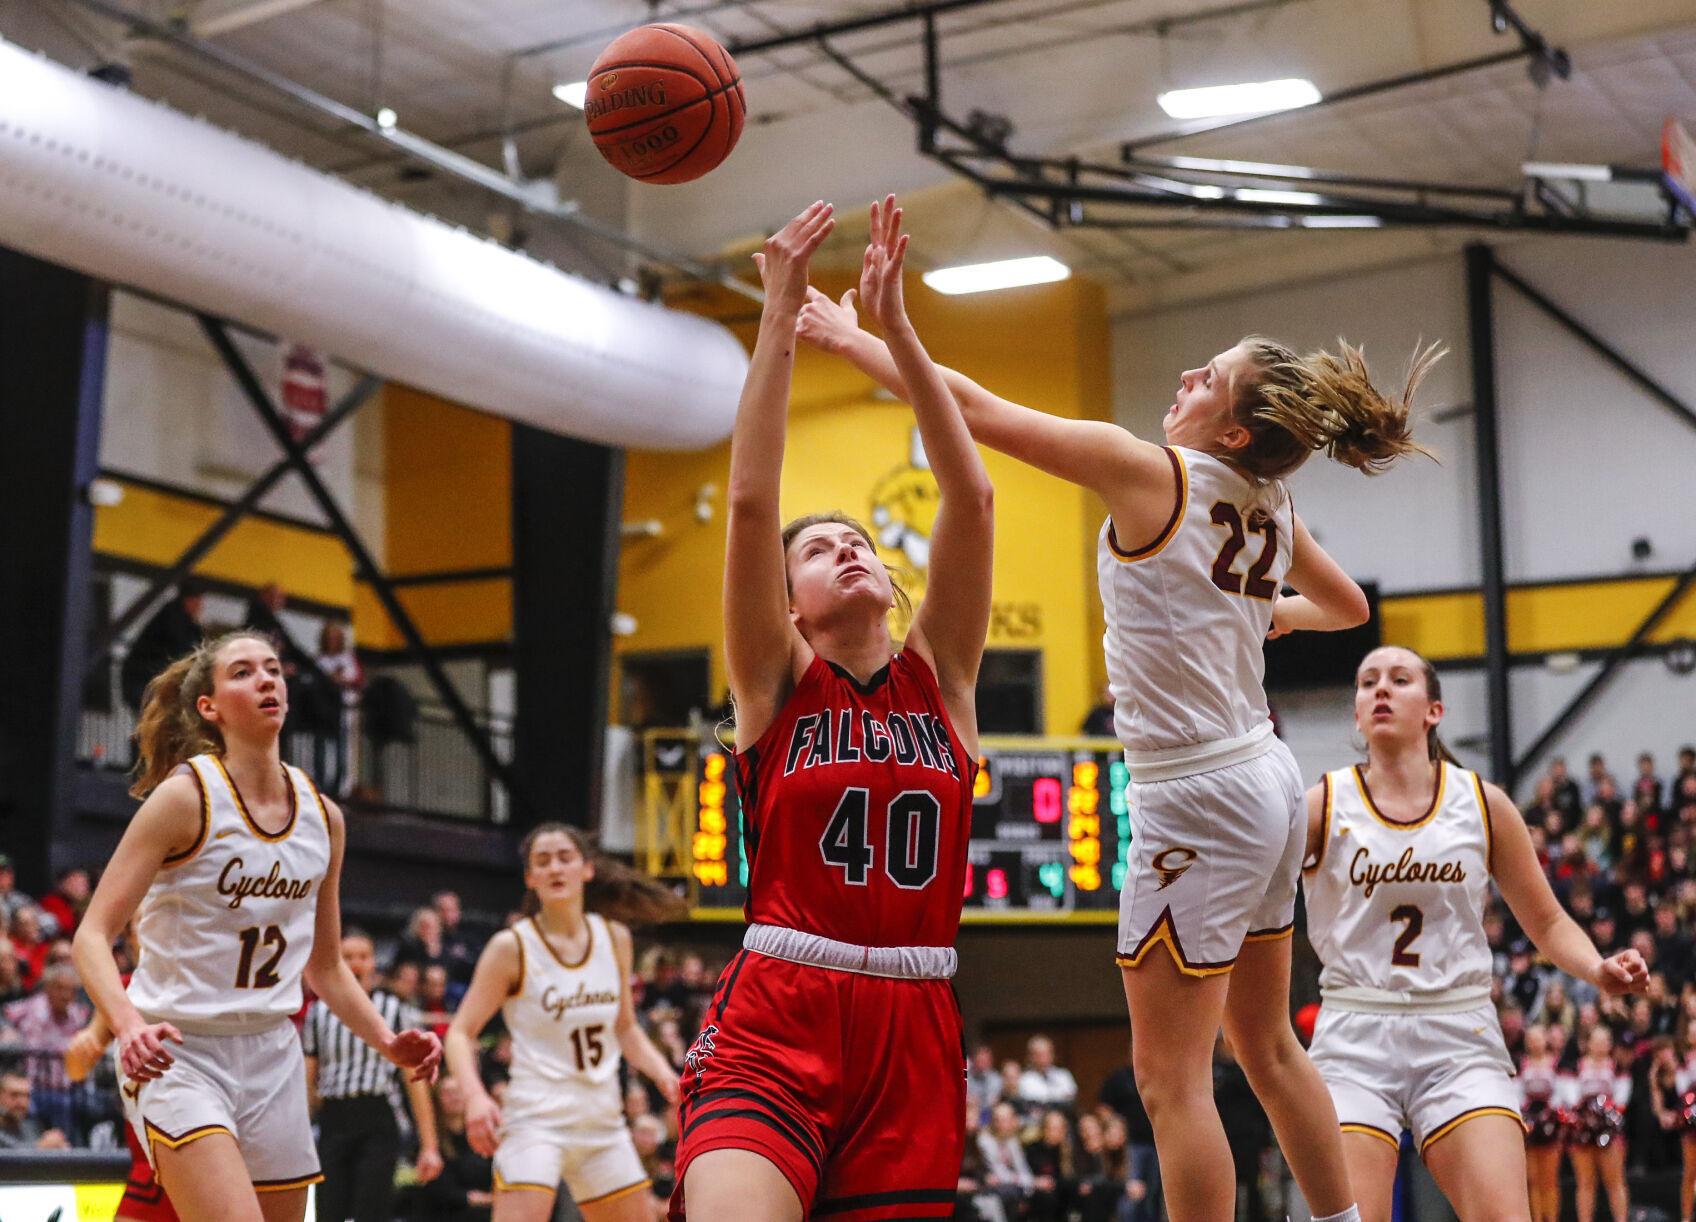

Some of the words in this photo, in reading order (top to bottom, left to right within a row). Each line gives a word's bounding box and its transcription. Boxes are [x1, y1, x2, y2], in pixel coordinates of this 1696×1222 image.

[1209, 499, 1277, 600] 22
[784, 708, 960, 781] FALCONS
[818, 786, 941, 890] 40
[1349, 846, 1466, 898] Cyclones
[234, 925, 288, 989] 12
[1389, 904, 1423, 967] 2
[570, 1024, 604, 1071] 15
